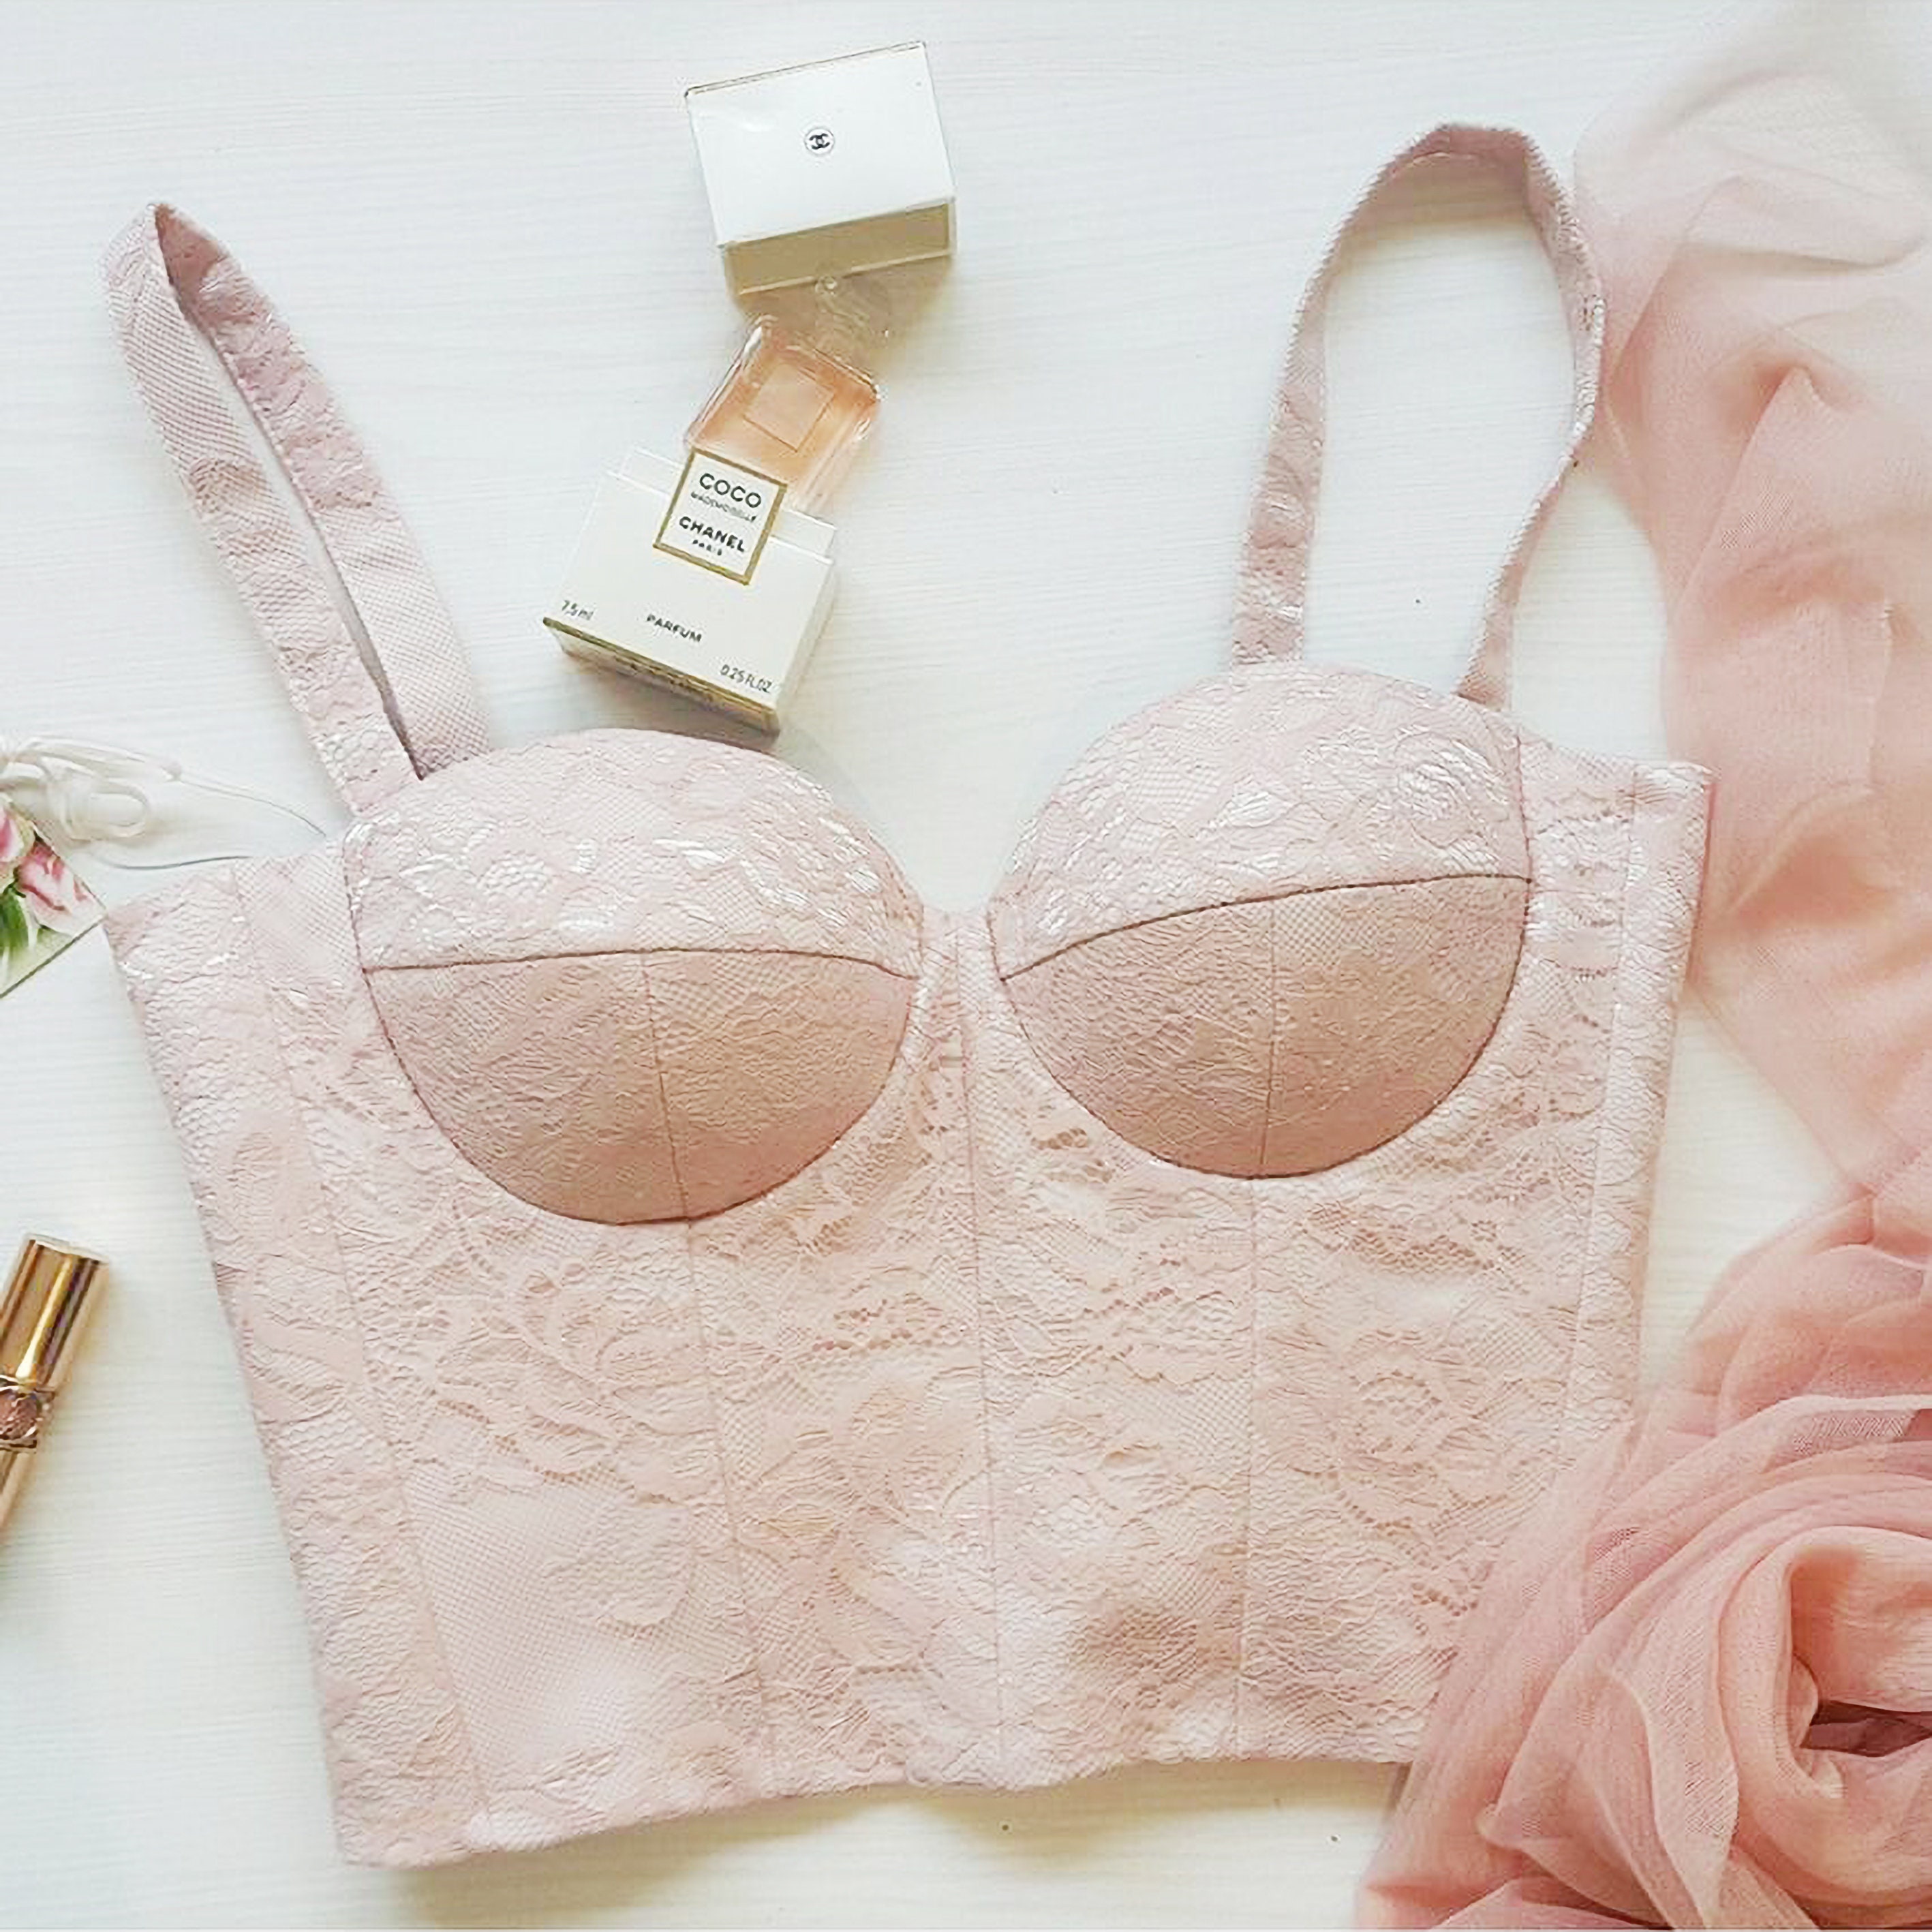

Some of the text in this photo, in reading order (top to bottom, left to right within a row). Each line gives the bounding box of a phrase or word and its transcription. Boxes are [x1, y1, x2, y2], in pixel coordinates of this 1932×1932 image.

[699, 473, 761, 508] COCO
[679, 516, 745, 552] CHANEL
[646, 614, 702, 643] PARFUM
